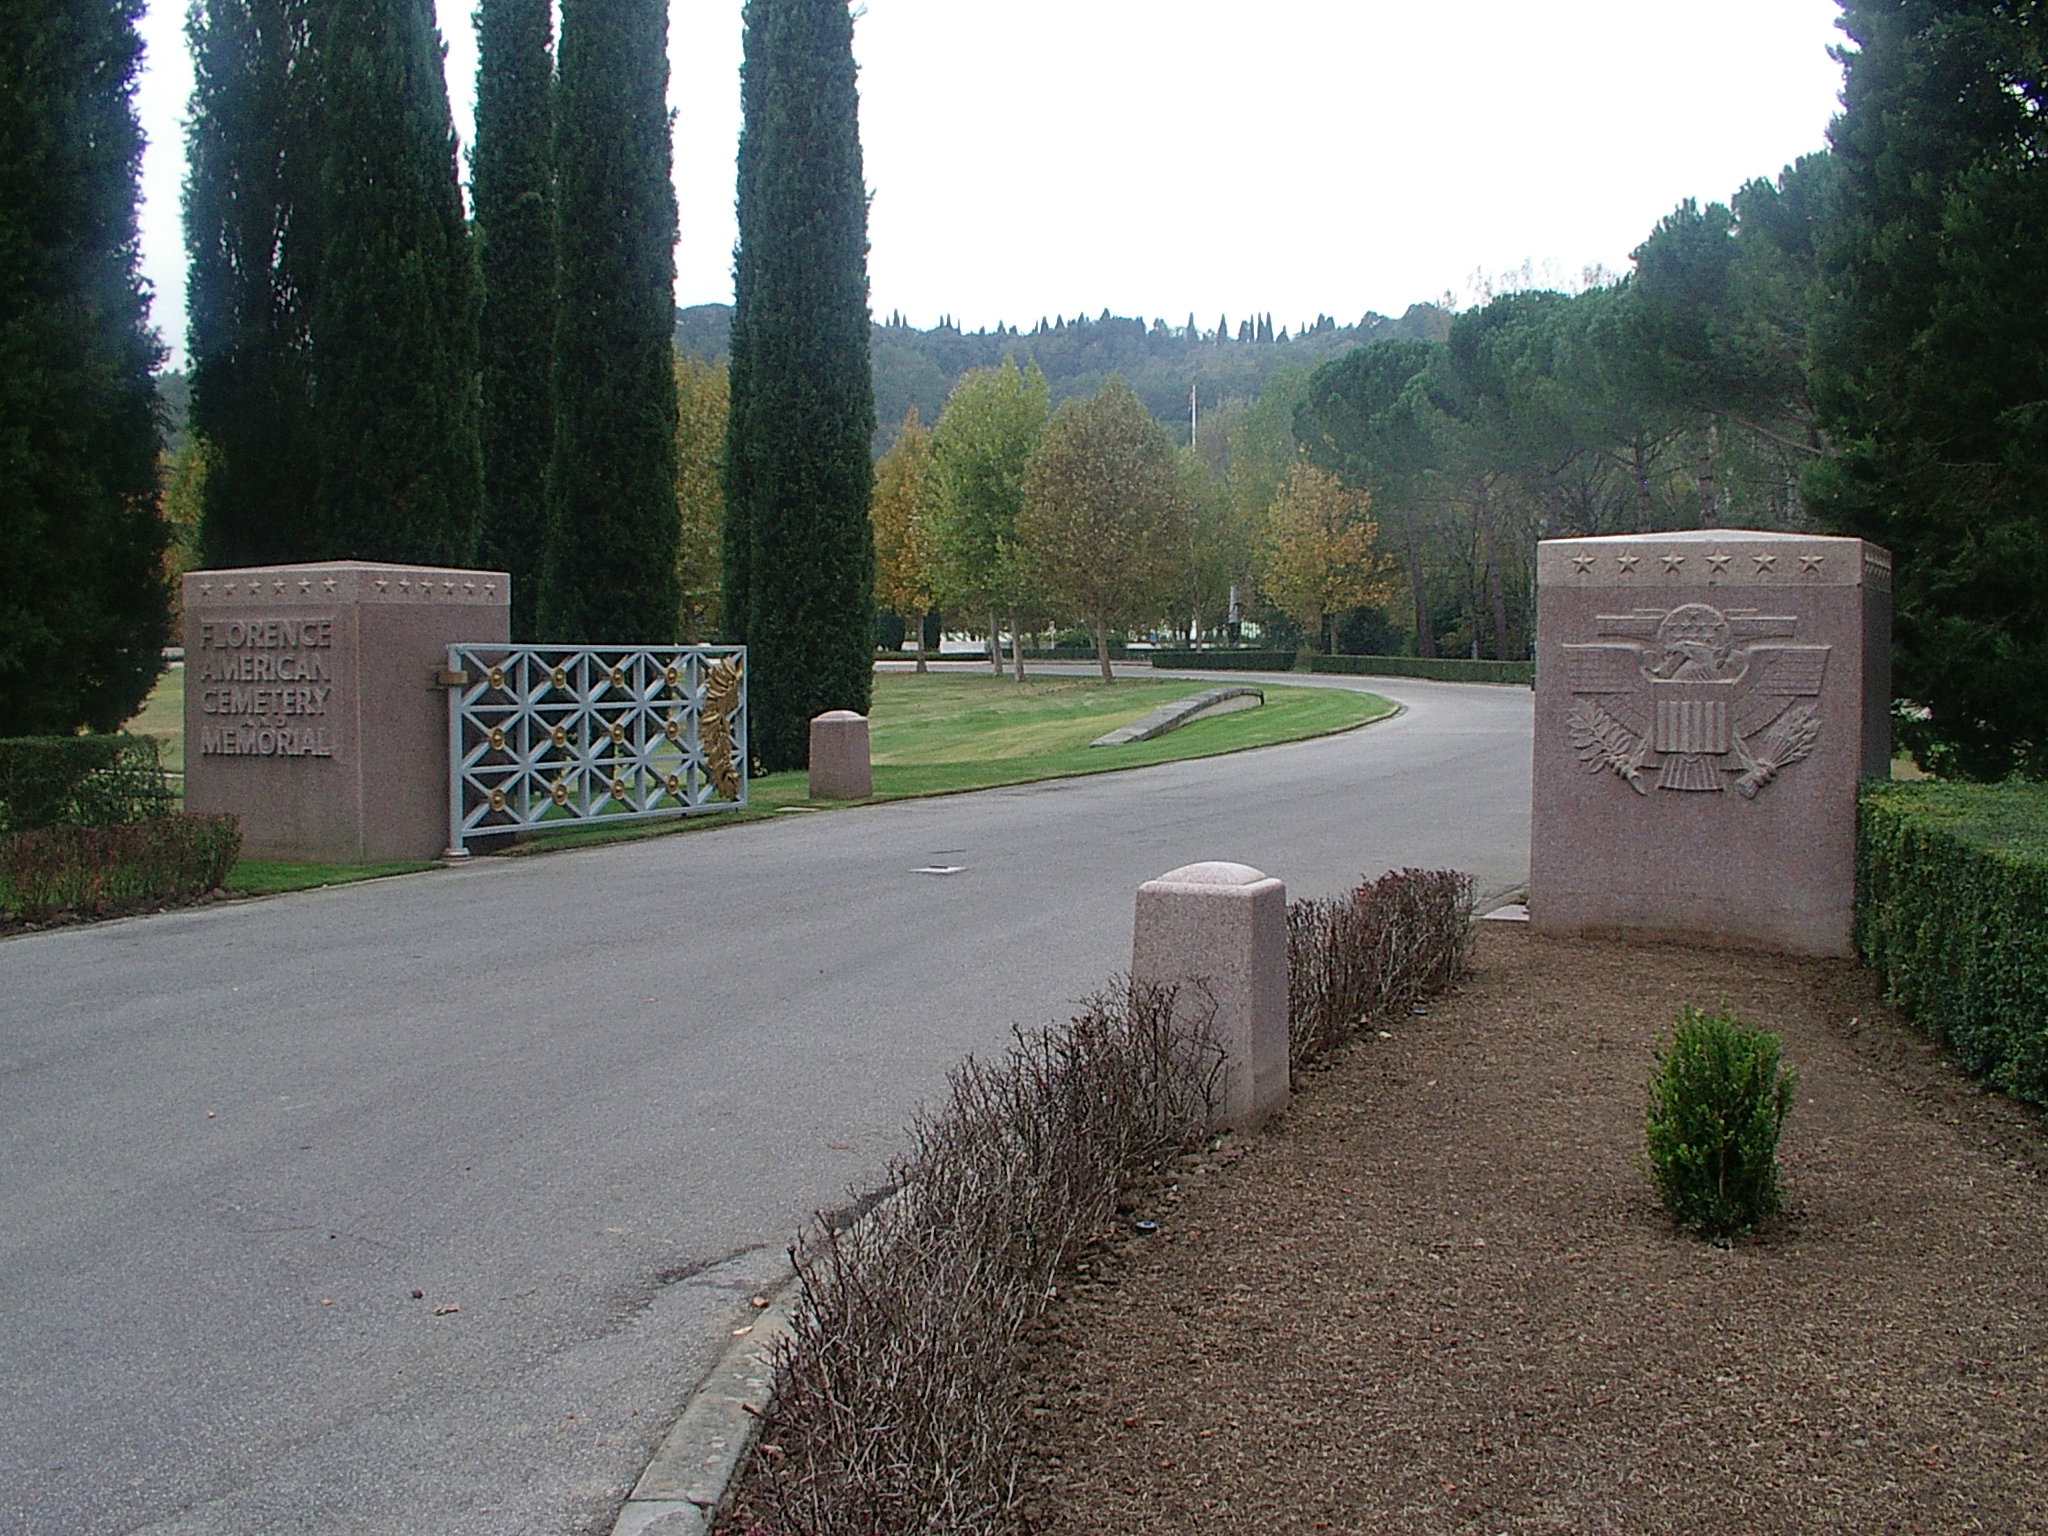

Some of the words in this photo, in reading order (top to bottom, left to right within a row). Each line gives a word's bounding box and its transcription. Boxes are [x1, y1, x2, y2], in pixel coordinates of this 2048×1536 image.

[201, 620, 332, 649] FLORENCE
[201, 653, 332, 683] AMERICAN
[202, 686, 331, 716] CEMETERY
[202, 728, 332, 757] MEMORIAL
